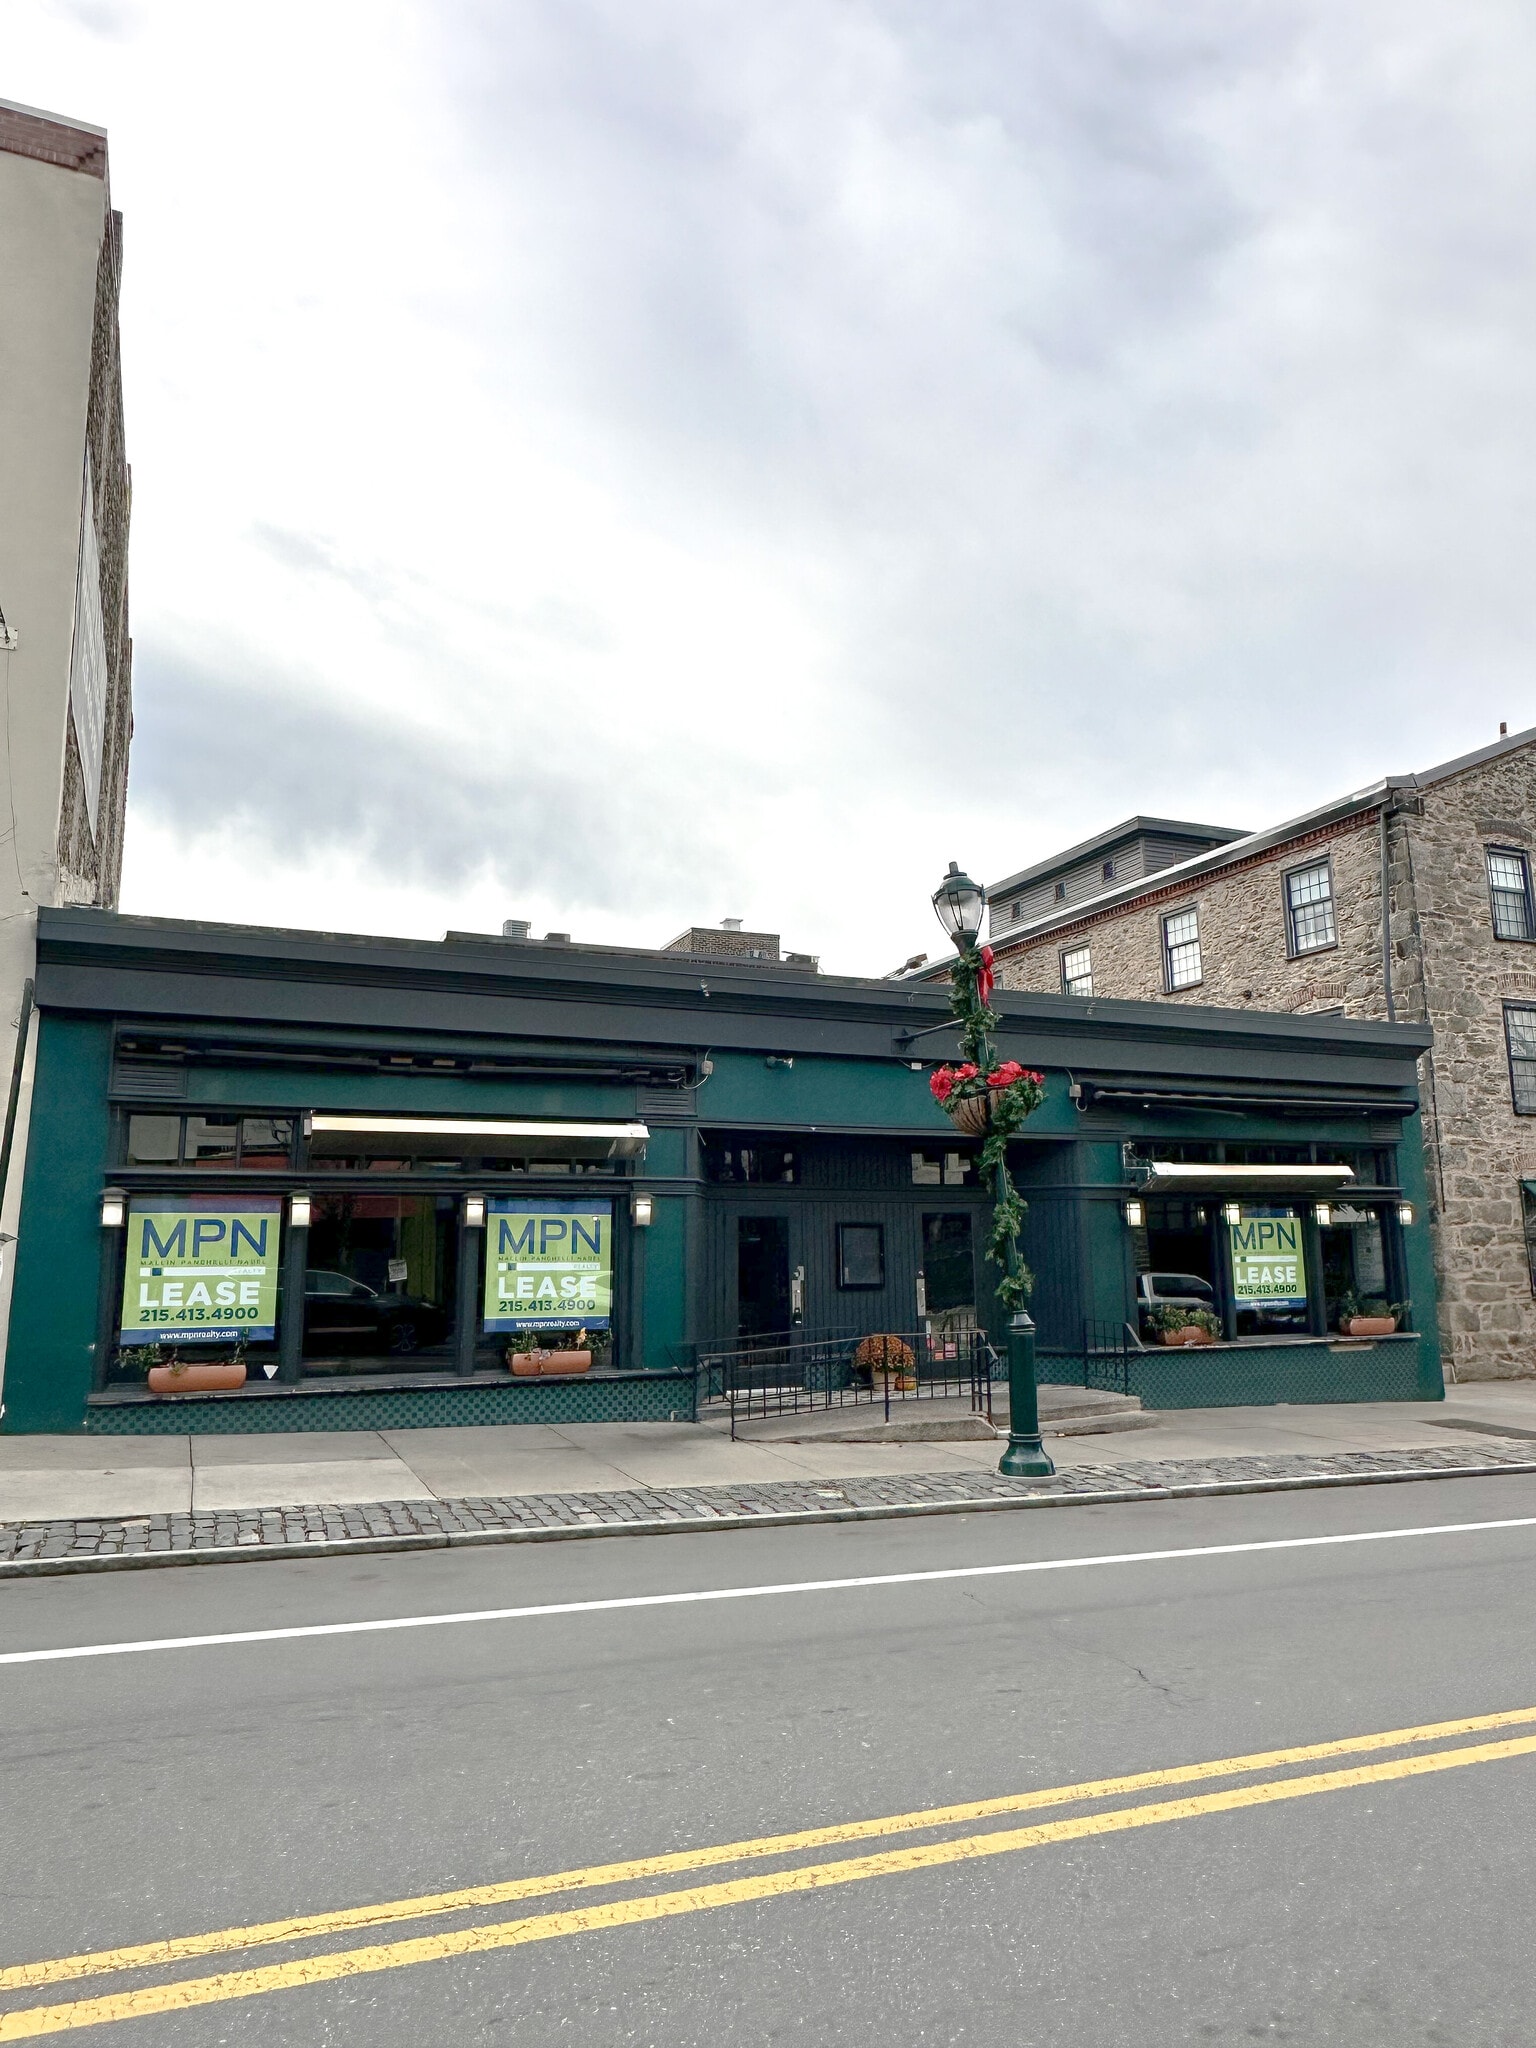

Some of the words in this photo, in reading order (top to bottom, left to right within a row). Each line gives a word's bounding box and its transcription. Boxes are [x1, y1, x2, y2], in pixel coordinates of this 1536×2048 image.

[141, 1219, 268, 1258] MPN
[498, 1219, 601, 1255] MPN
[1233, 1222, 1296, 1250] MPN
[1235, 1266, 1297, 1284] LEASE
[139, 1281, 261, 1307] LEASE
[498, 1276, 597, 1299] LEASE
[1238, 1284, 1297, 1295] 215.413.4900
[139, 1307, 259, 1322] 215.413.4900
[498, 1299, 596, 1312] 215.413.4900
[160, 1329, 238, 1340] www.mpnrealty.com
